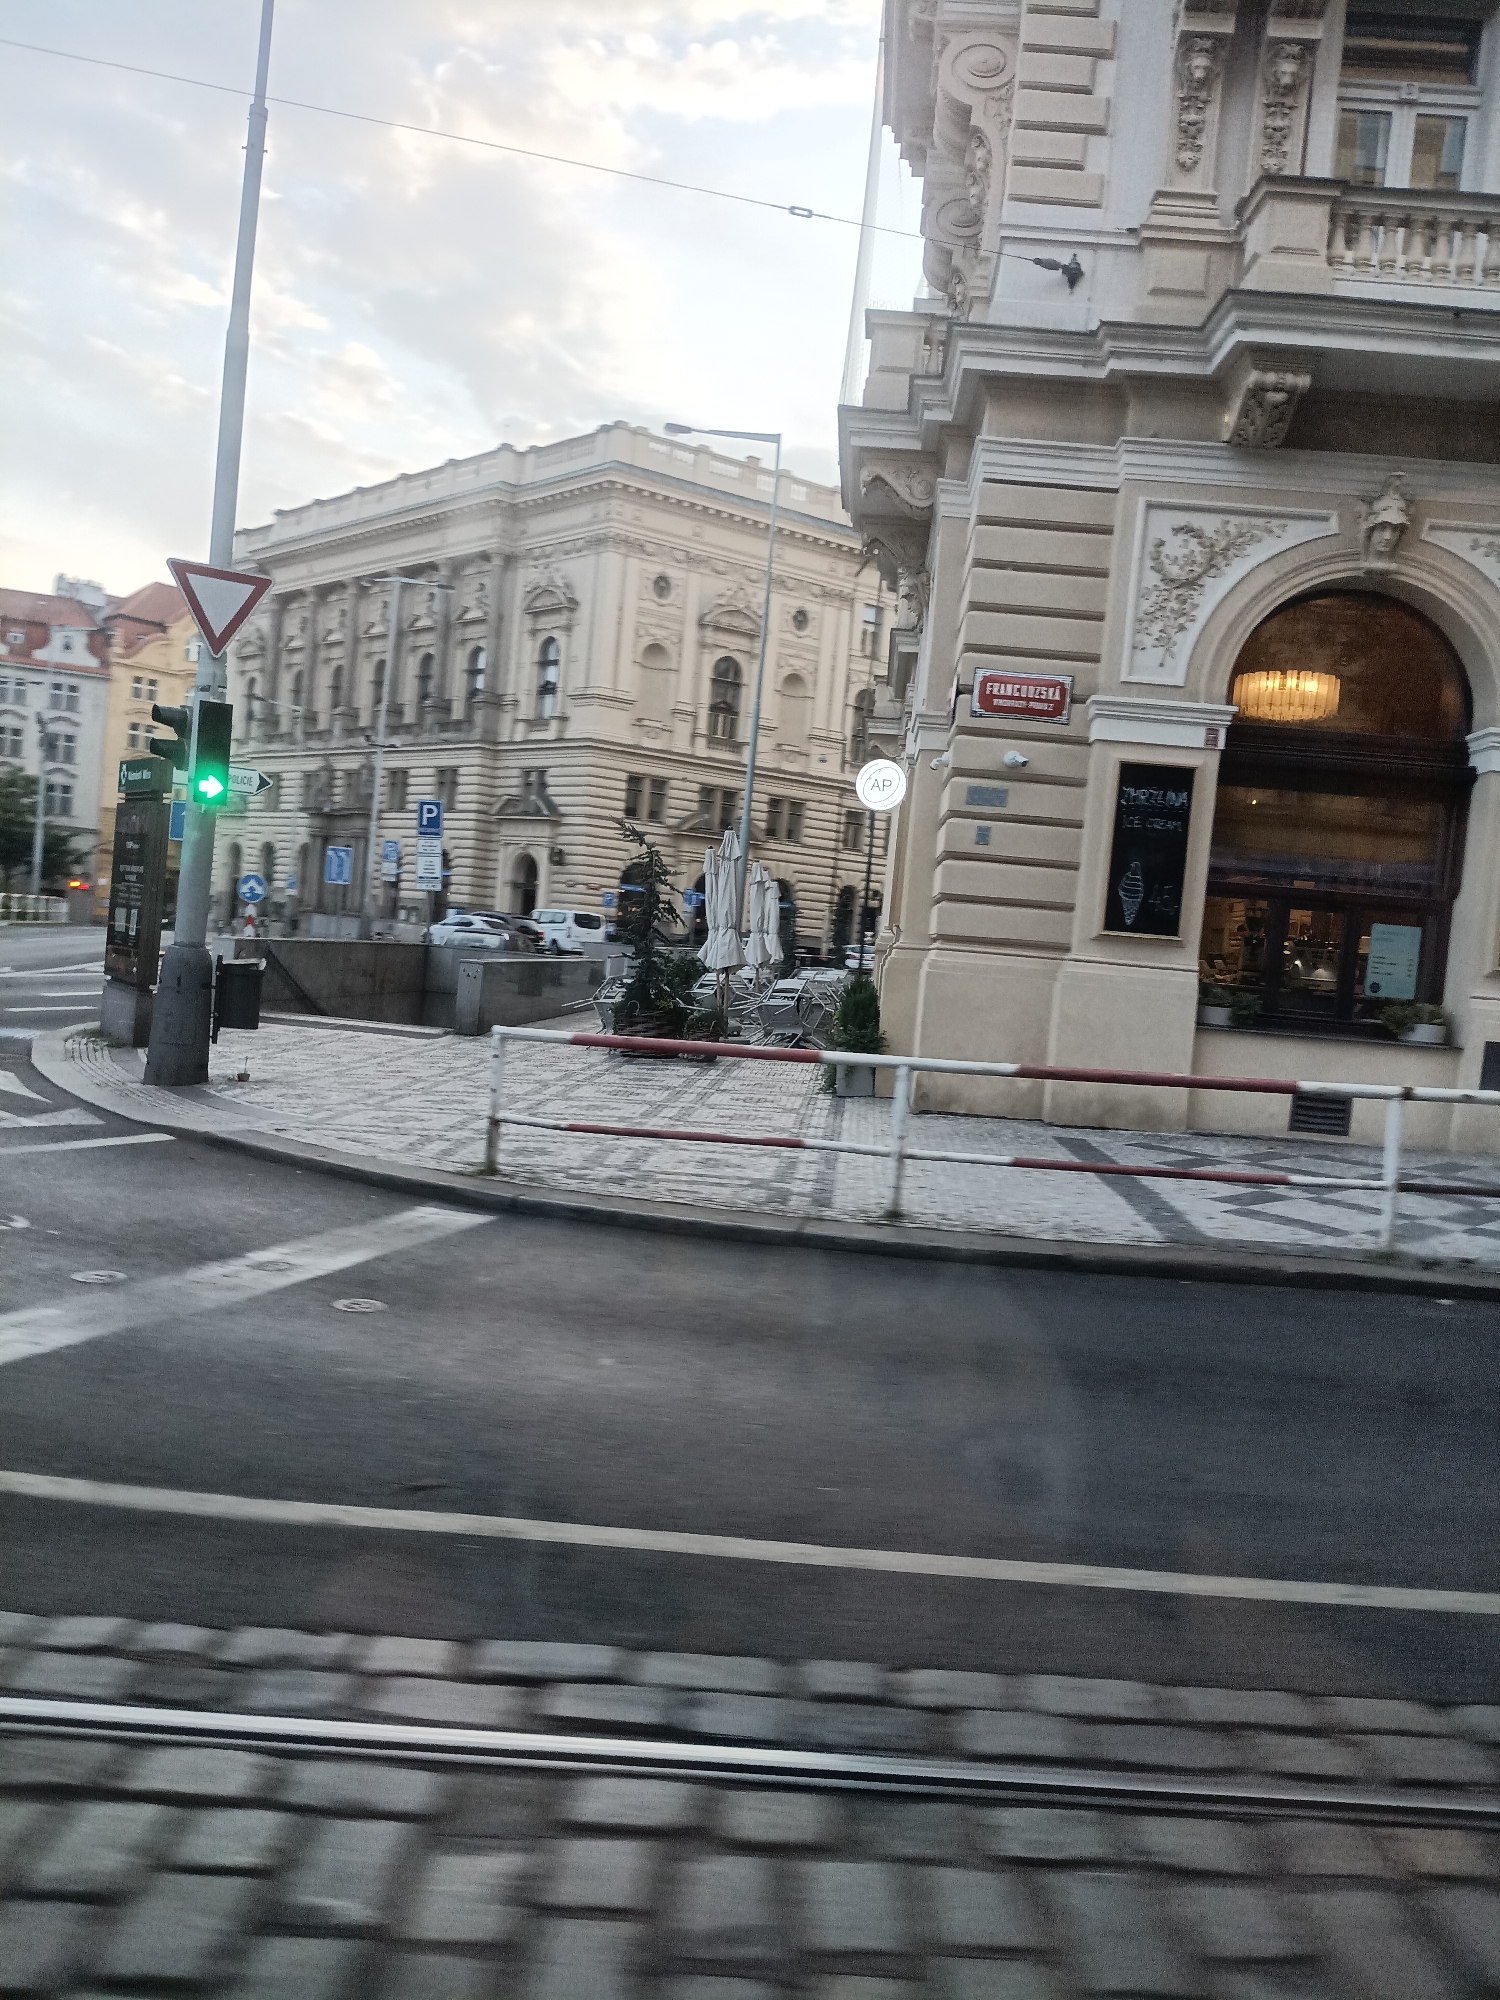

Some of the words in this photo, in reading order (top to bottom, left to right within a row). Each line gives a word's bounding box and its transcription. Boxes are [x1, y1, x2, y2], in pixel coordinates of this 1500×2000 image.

[228, 773, 254, 787] POLICIE
[870, 778, 893, 791] AP
[421, 804, 438, 826] P
